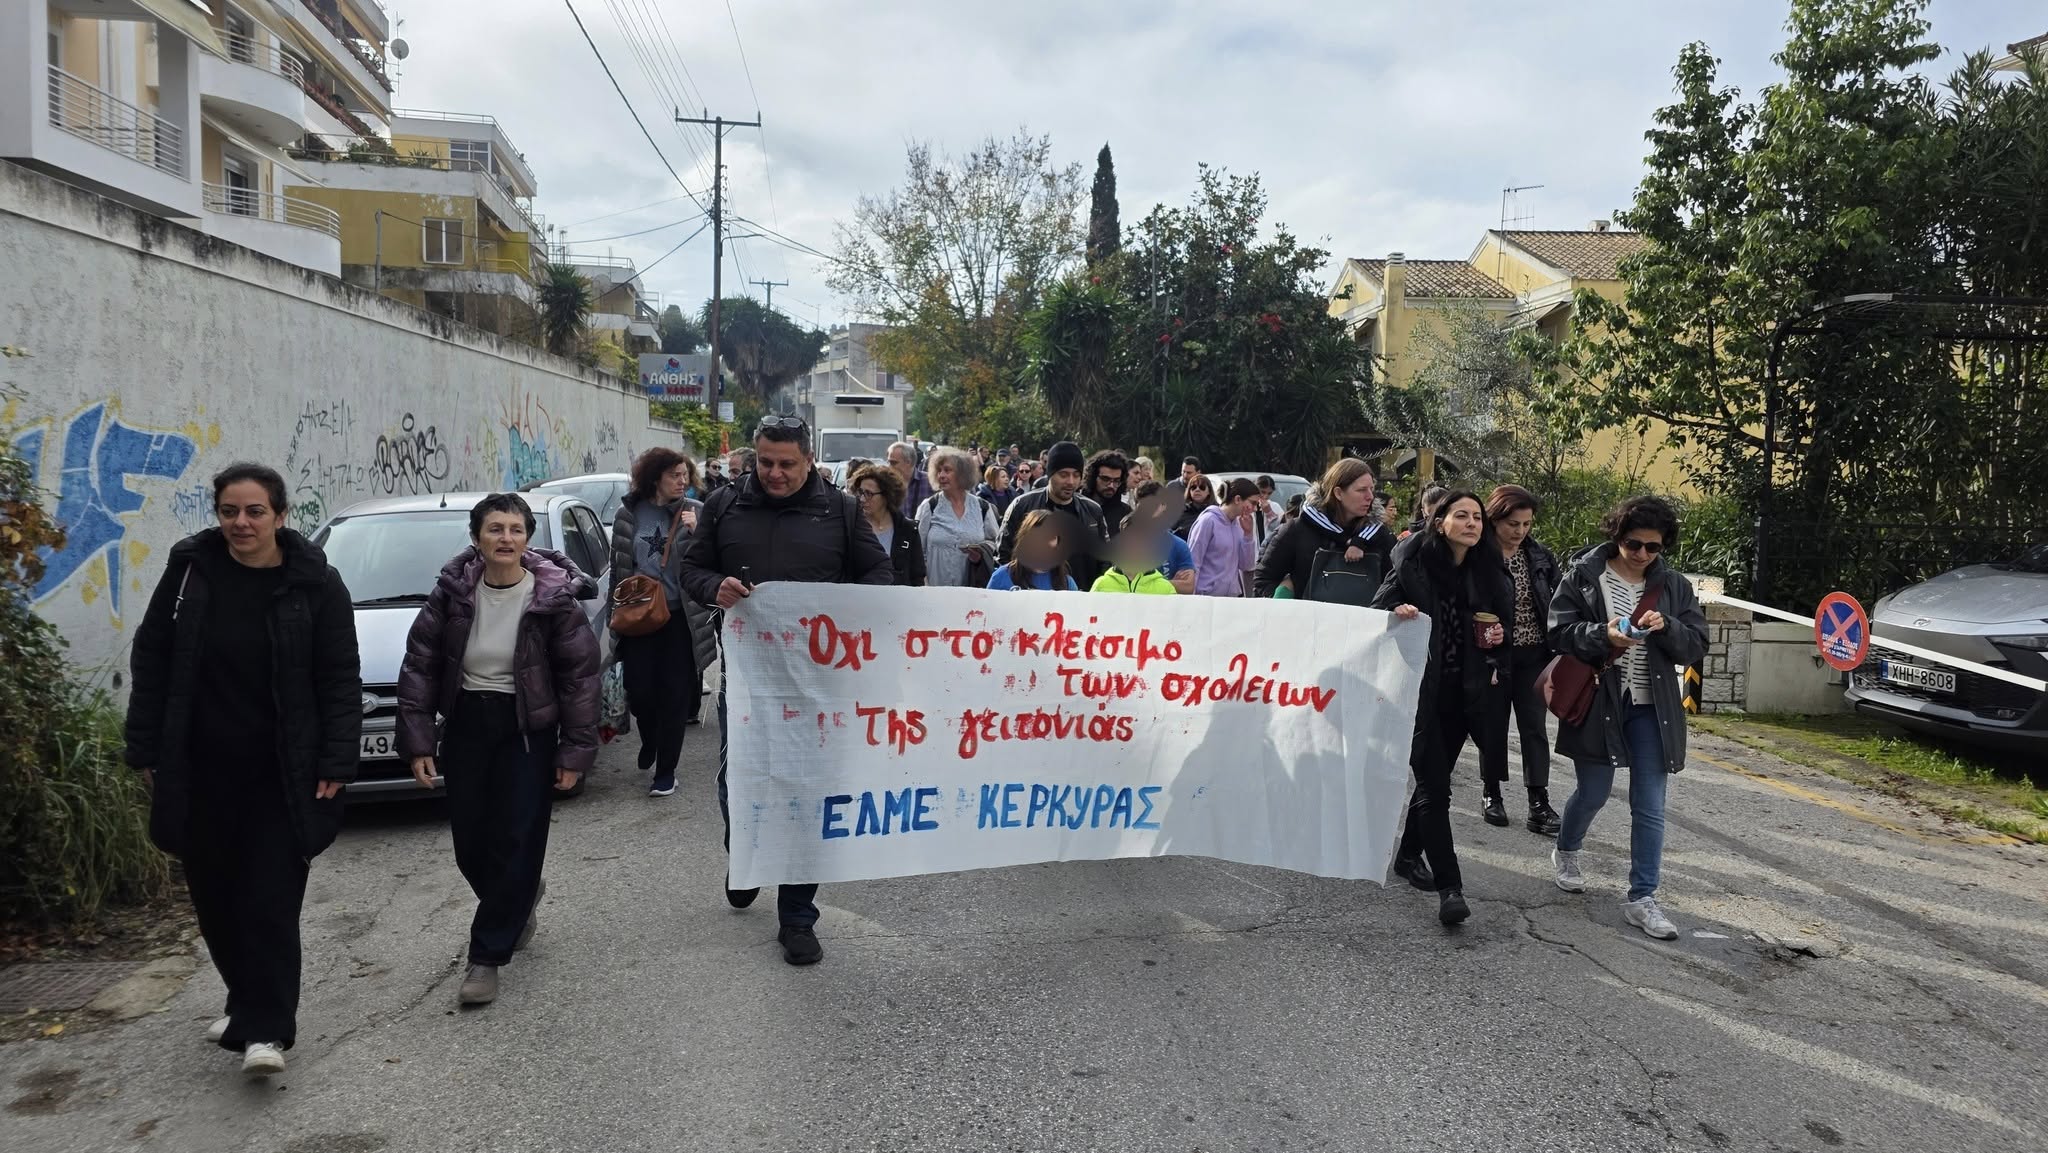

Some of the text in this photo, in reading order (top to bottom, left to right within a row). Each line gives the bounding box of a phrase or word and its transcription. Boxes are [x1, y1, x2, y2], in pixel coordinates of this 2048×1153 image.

[799, 614, 877, 671] Όχι
[1017, 612, 1183, 670] κλείσιμο
[1057, 653, 1337, 712] των σχολείων
[1892, 664, 1954, 690] XHH-8608
[957, 702, 1134, 759] γειτονιάς
[822, 783, 1163, 840] ΕΛΜΕ ΚΕΡΚΥΡΑΣ
